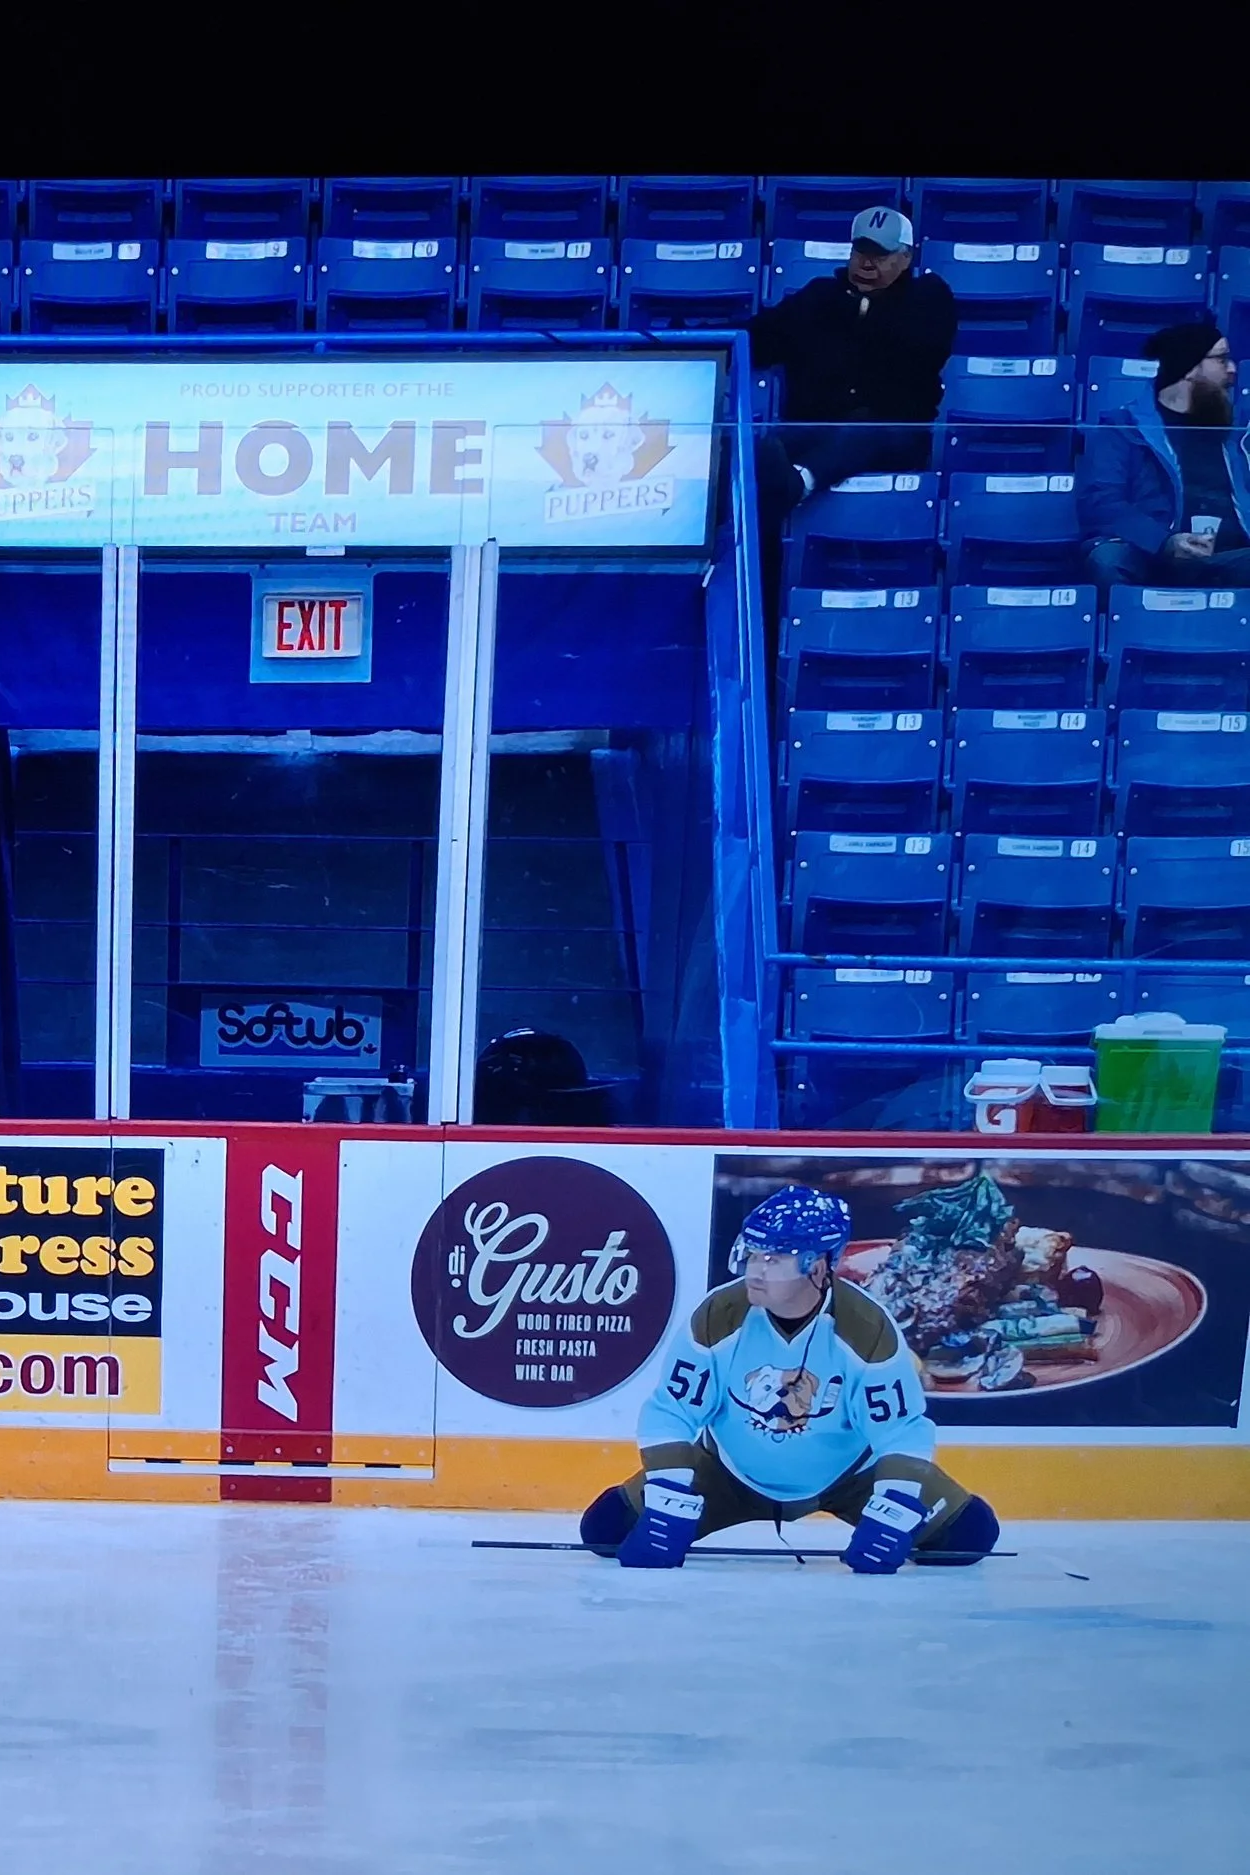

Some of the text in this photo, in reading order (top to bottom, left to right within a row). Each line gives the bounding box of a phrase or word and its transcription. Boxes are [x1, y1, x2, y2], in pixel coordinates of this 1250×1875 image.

[869, 210, 888, 230] N
[180, 383, 455, 398] PROUD SUPPORTER OF THE
[143, 420, 486, 496] HOME
[548, 480, 669, 520] PUPPERS
[267, 512, 357, 534] TEAM
[276, 600, 348, 651] EXIT
[217, 1002, 366, 1047] Softub
[976, 1088, 1017, 1134] G
[448, 1201, 639, 1338] di Gusto
[257, 1163, 303, 1423] CCM
[517, 1313, 631, 1333] WOOD FIRED PIZZA
[515, 1339, 596, 1357] FRESH PASTA
[515, 1364, 574, 1382] WINE BAR
[666, 1358, 711, 1407] 51
[864, 1379, 909, 1423] 51
